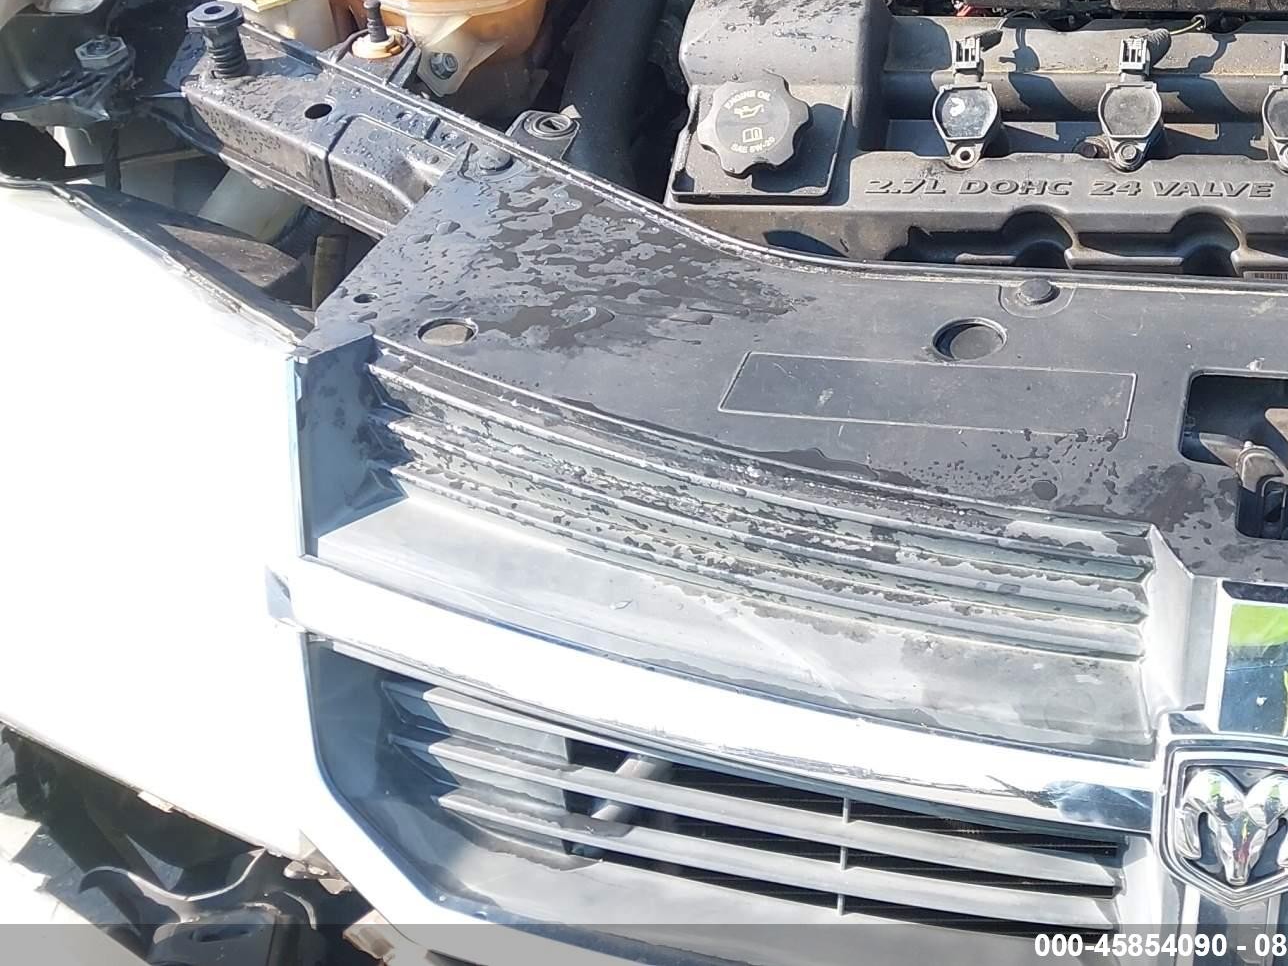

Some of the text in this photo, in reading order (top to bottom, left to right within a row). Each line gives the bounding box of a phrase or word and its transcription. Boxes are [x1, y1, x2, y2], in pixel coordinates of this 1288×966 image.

[723, 89, 772, 110] ENGINE OIL
[730, 143, 748, 154] SAE
[863, 178, 1274, 199] 2.7L DOHC 24 VALVE
